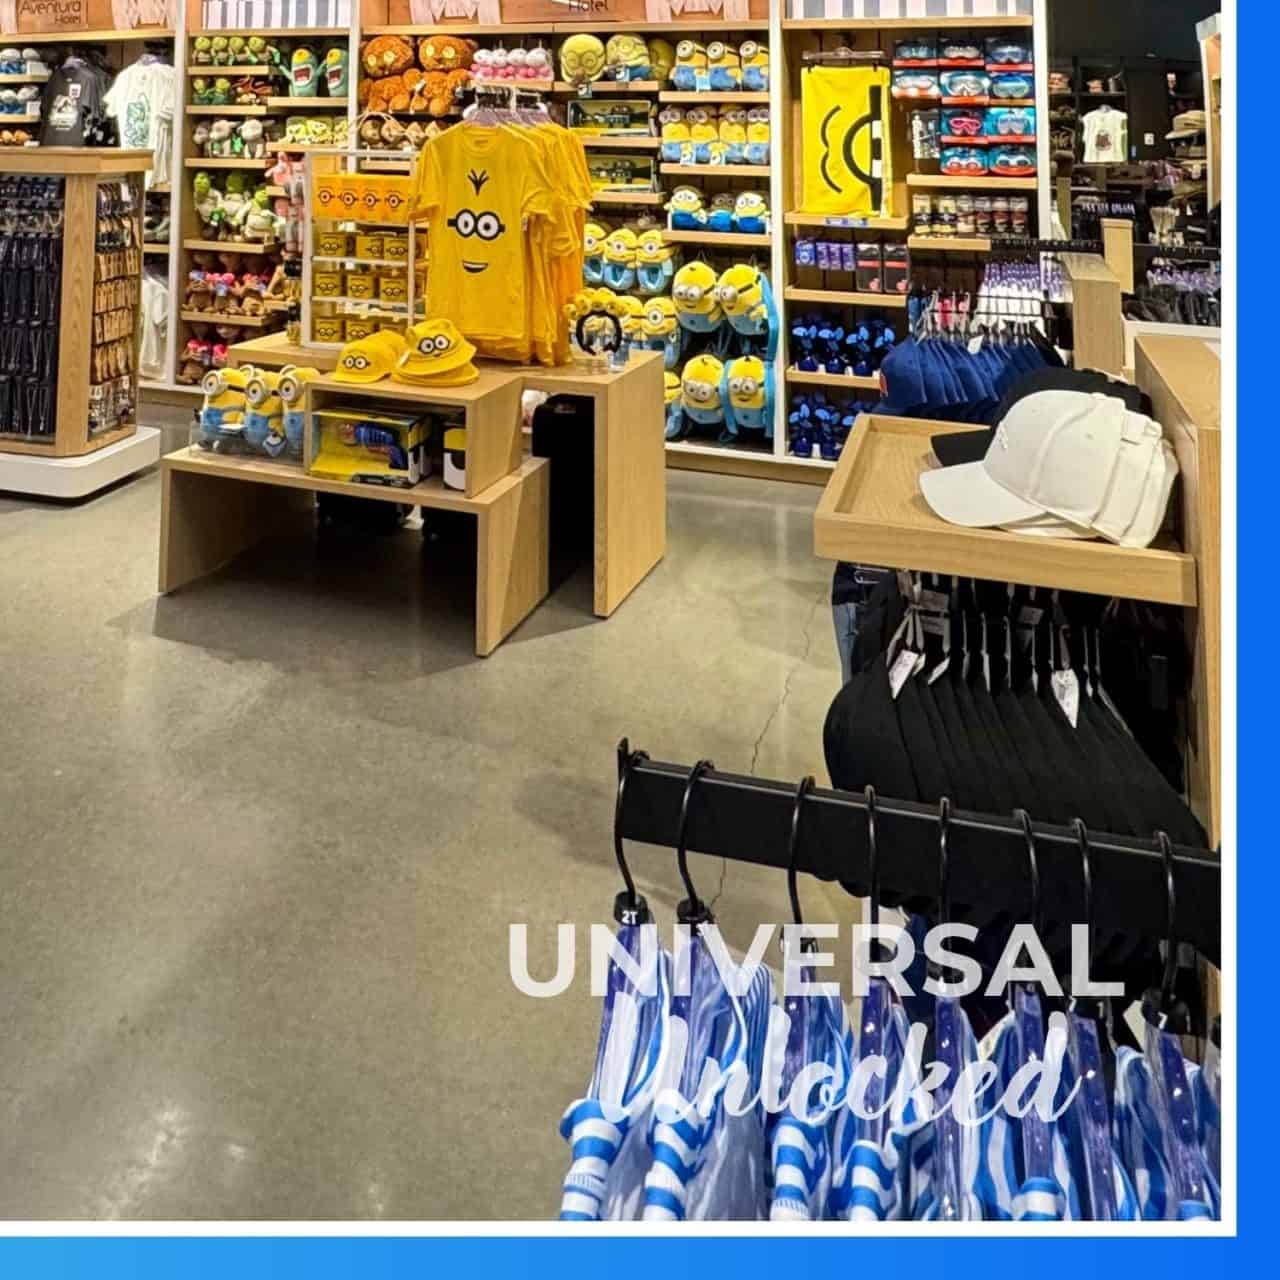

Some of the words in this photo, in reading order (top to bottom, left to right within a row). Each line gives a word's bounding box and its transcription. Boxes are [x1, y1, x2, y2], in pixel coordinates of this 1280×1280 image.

[19, 0, 82, 15] Aventura
[54, 14, 82, 25] Hotel
[621, 910, 639, 926] 2T
